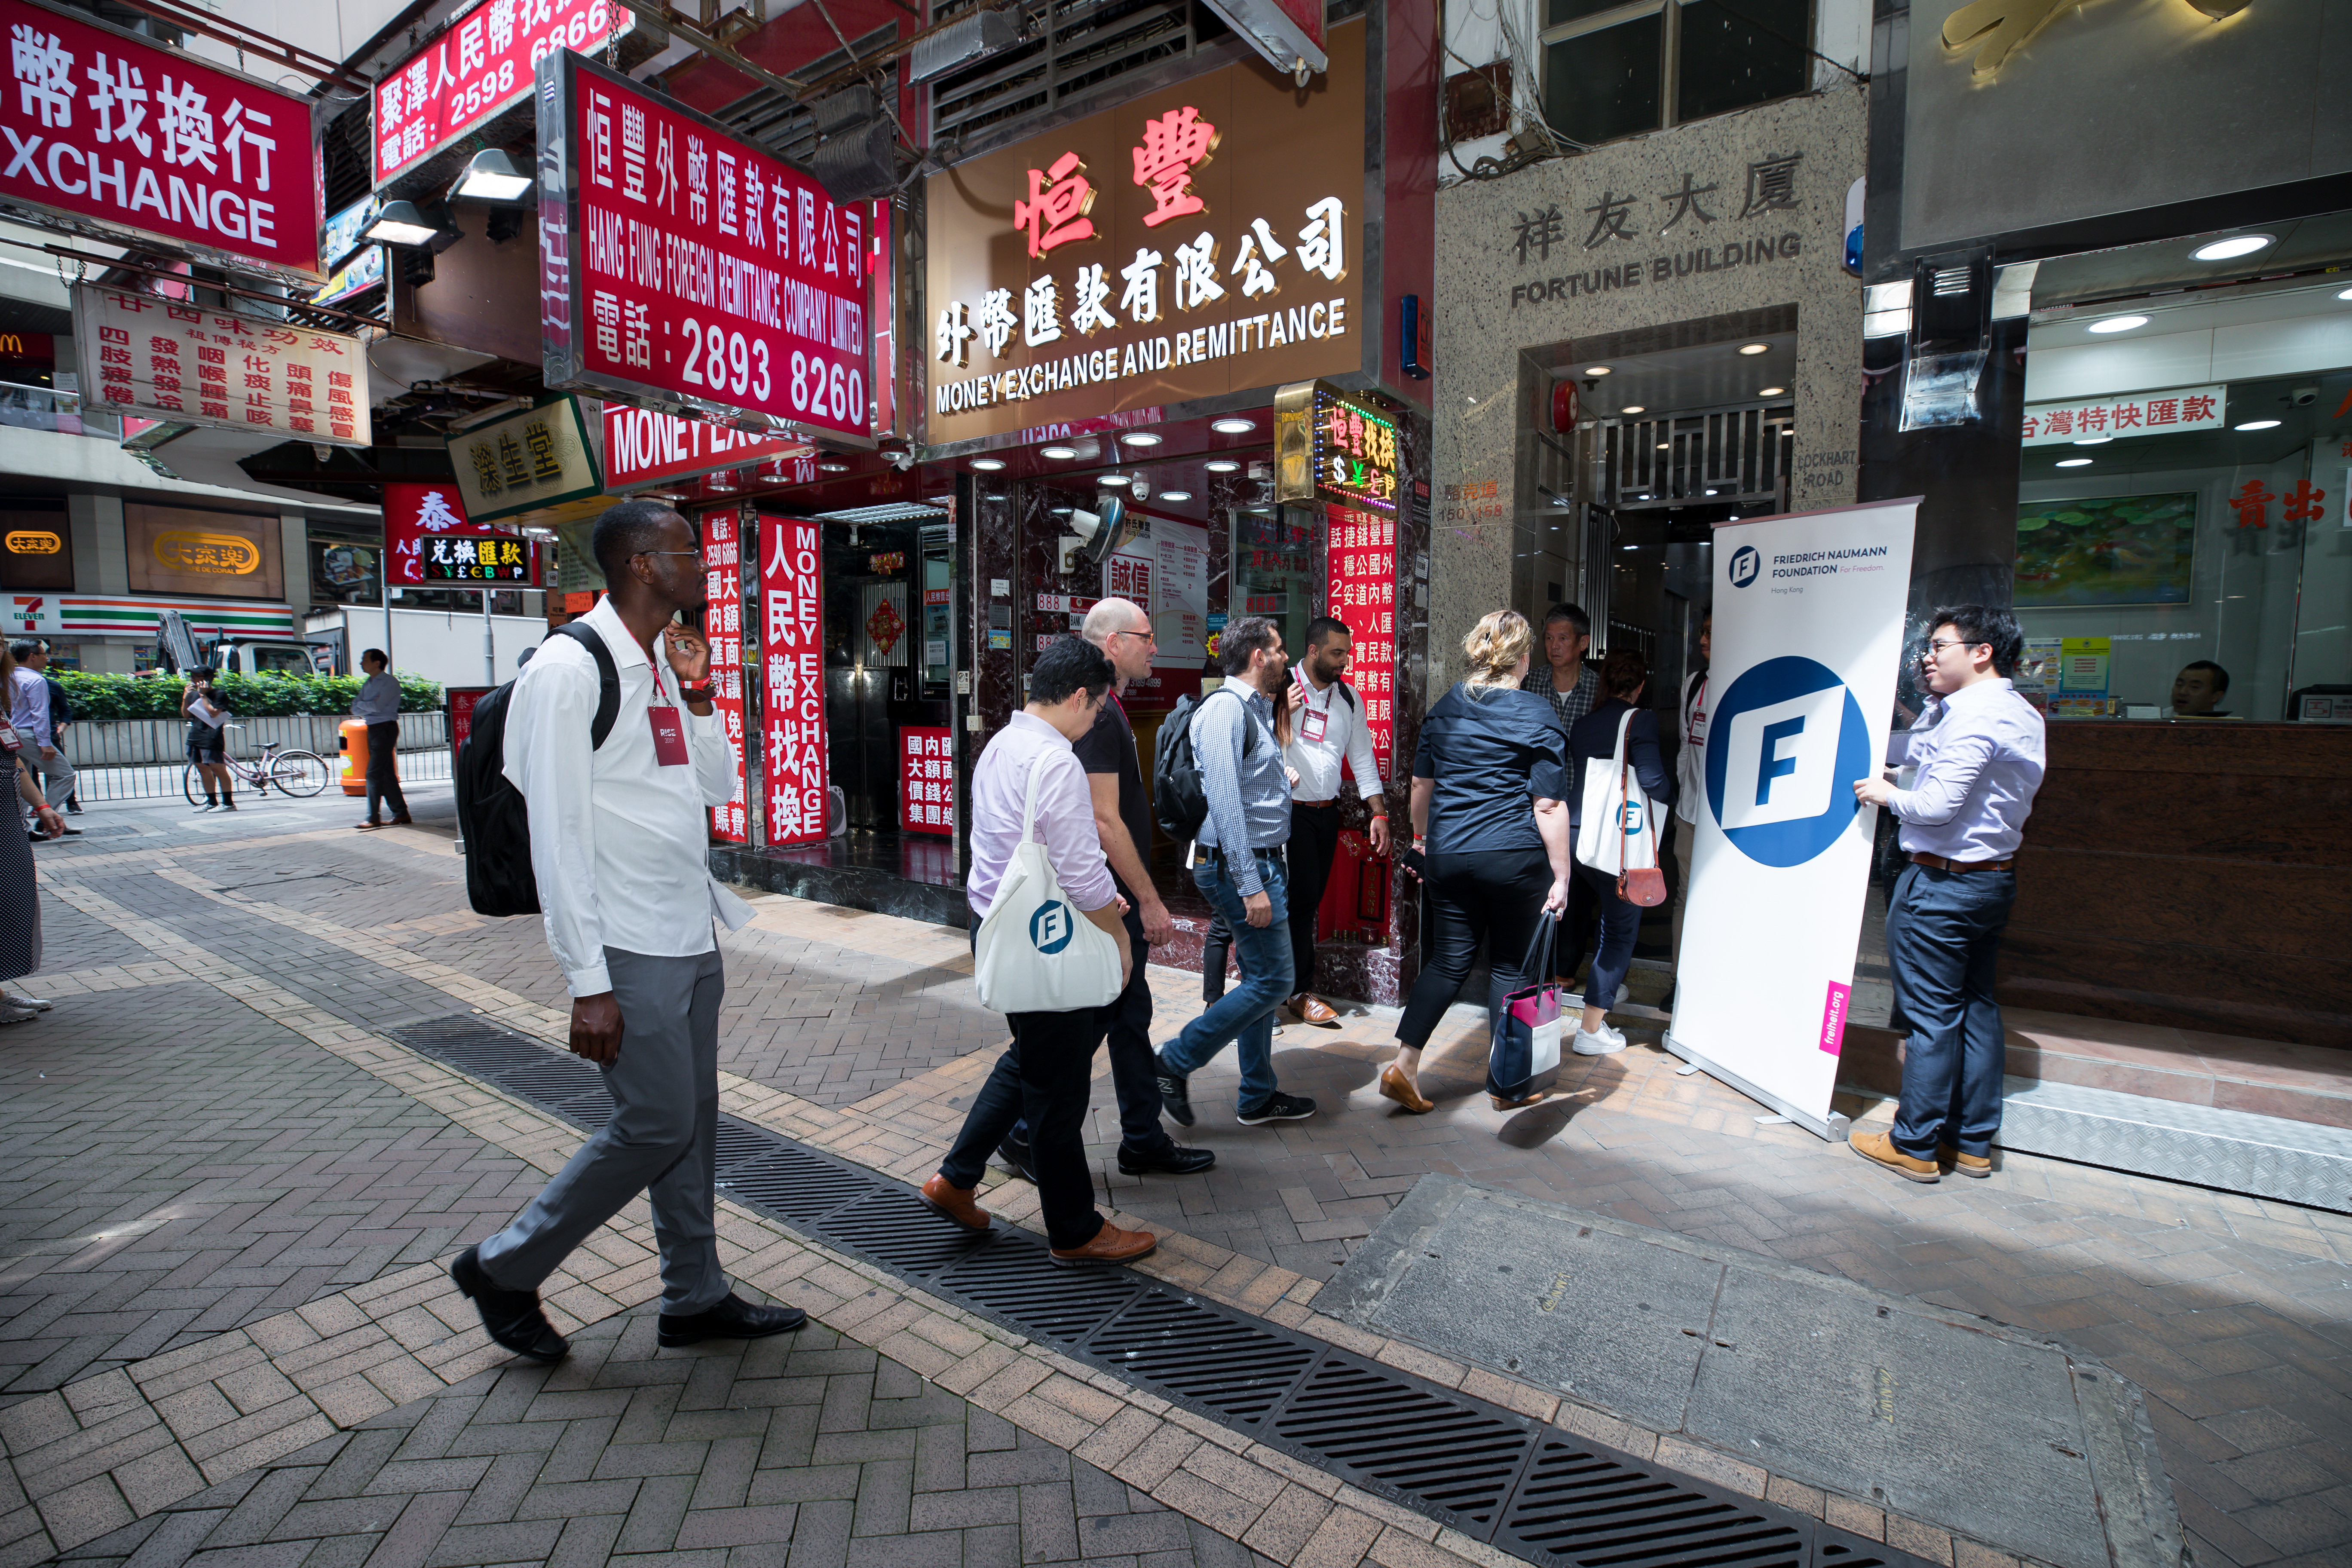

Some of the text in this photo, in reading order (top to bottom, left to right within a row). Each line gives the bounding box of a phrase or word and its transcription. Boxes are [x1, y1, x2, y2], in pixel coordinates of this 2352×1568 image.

[450, 1, 607, 126] 2598 6866
[11, 24, 276, 192] 幣找換行
[587, 88, 861, 288] 恒豐外幣匯款有限公司
[1014, 106, 1215, 259] 恒豐
[1511, 150, 1804, 266] 祥友大廈
[588, 204, 862, 355] HANG FUNG FOREIGN REMITTANCE COMPANY LIMITED
[936, 196, 1344, 368] 外幣匯款有限公司
[1511, 232, 1801, 308] FORTUNE BUILDING
[108, 294, 344, 355] 廿四味功效
[936, 297, 1345, 414] MONEY EXCHANGE AND REMITTANCE
[99, 326, 135, 405] 四肢疲倦
[149, 336, 184, 412] 發熱發冷
[198, 346, 229, 420] 咽喉腫痛
[243, 355, 273, 427] 化痰止咳
[286, 363, 314, 432] 頭痛鼻塞
[682, 318, 771, 401] 2893
[791, 350, 862, 426] 8260
[328, 371, 354, 438] 傷風感冒
[2022, 395, 2217, 439] 台灣特快匯款
[614, 410, 701, 474] MONEY
[1330, 406, 1395, 471] 恒豐找換
[1333, 456, 1346, 484] $
[1352, 460, 1364, 488] ¥
[1798, 450, 1856, 469] LOCKHART
[1445, 479, 1498, 502] 駱克道
[1807, 470, 1844, 487] ROAD
[2229, 479, 2326, 529] 賣出
[707, 541, 738, 567] 2598 6866
[1111, 558, 1150, 596] 誠信
[1773, 546, 1887, 565] FRIEDRICH NAUMANN
[1773, 564, 1838, 578] FOUNDATION
[1070, 615, 1081, 626] BANK
[765, 524, 802, 841] 人民幣找換
[1146, 678, 1161, 687] 4899
[660, 729, 676, 737] RISE
[1755, 715, 1805, 806] F
[1824, 990, 1844, 1045] freiheit.org
